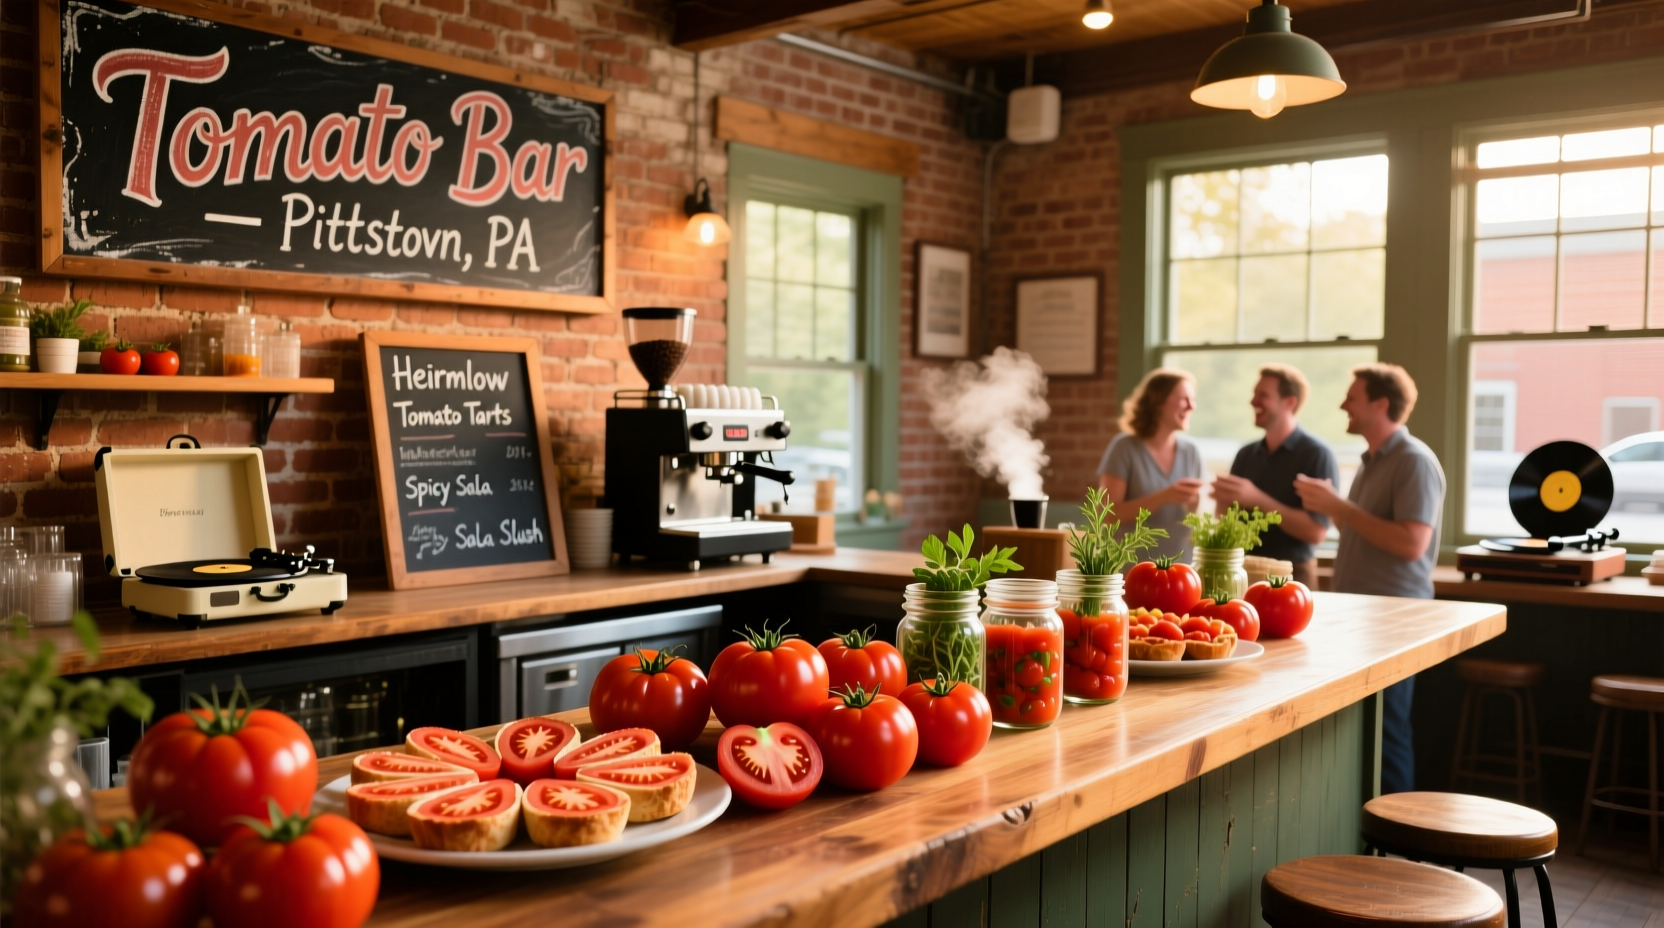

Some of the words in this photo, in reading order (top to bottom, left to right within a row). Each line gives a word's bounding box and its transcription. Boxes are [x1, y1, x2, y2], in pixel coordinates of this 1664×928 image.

[92, 45, 444, 208] Tomato
[448, 90, 588, 207] Bar
[484, 215, 541, 273] PA
[392, 354, 509, 391] Heirmlow
[392, 400, 462, 428] Tomato
[463, 401, 512, 426] Tarts
[405, 475, 451, 508] Spicy
[455, 473, 494, 497] Sala
[455, 521, 496, 550] Sala
